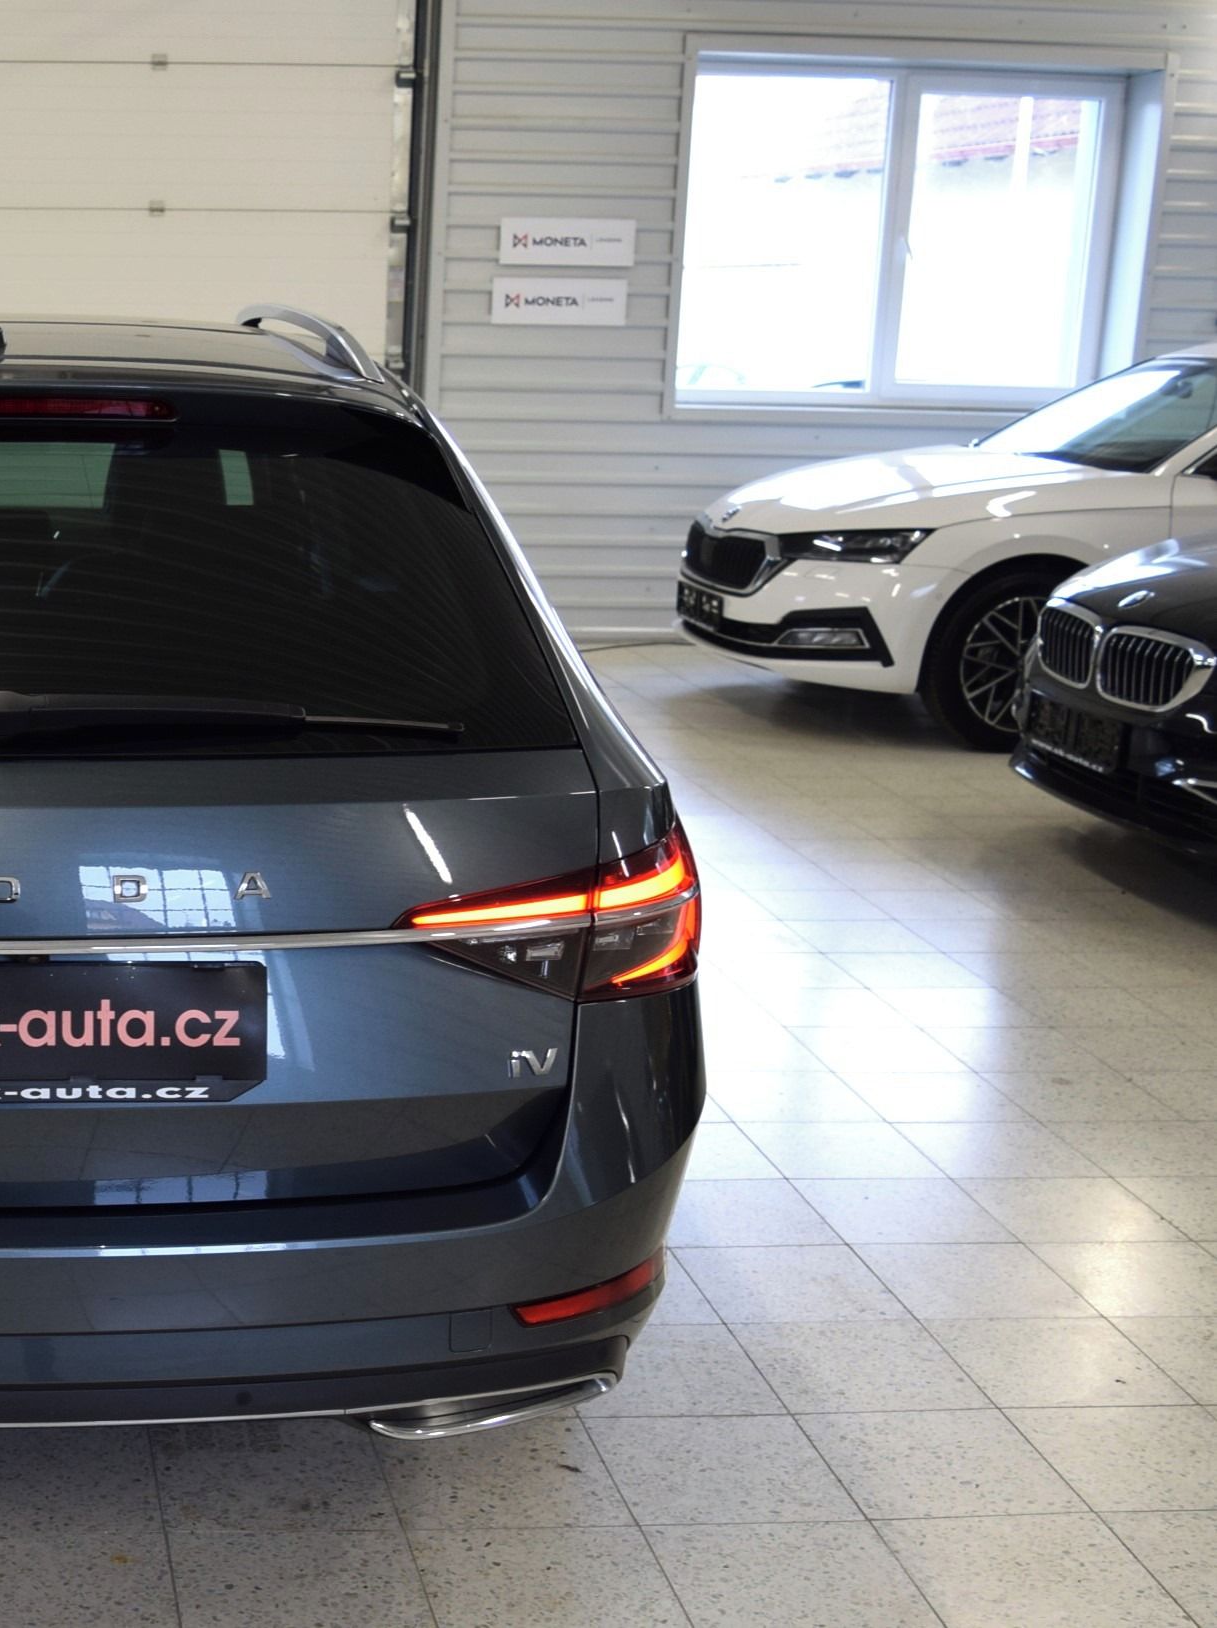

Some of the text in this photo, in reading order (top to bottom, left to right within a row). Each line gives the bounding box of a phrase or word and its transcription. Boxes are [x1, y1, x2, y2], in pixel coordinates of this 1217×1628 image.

[532, 236, 587, 248] MONETA
[523, 296, 579, 308] MONETA
[509, 1047, 559, 1078] iV
